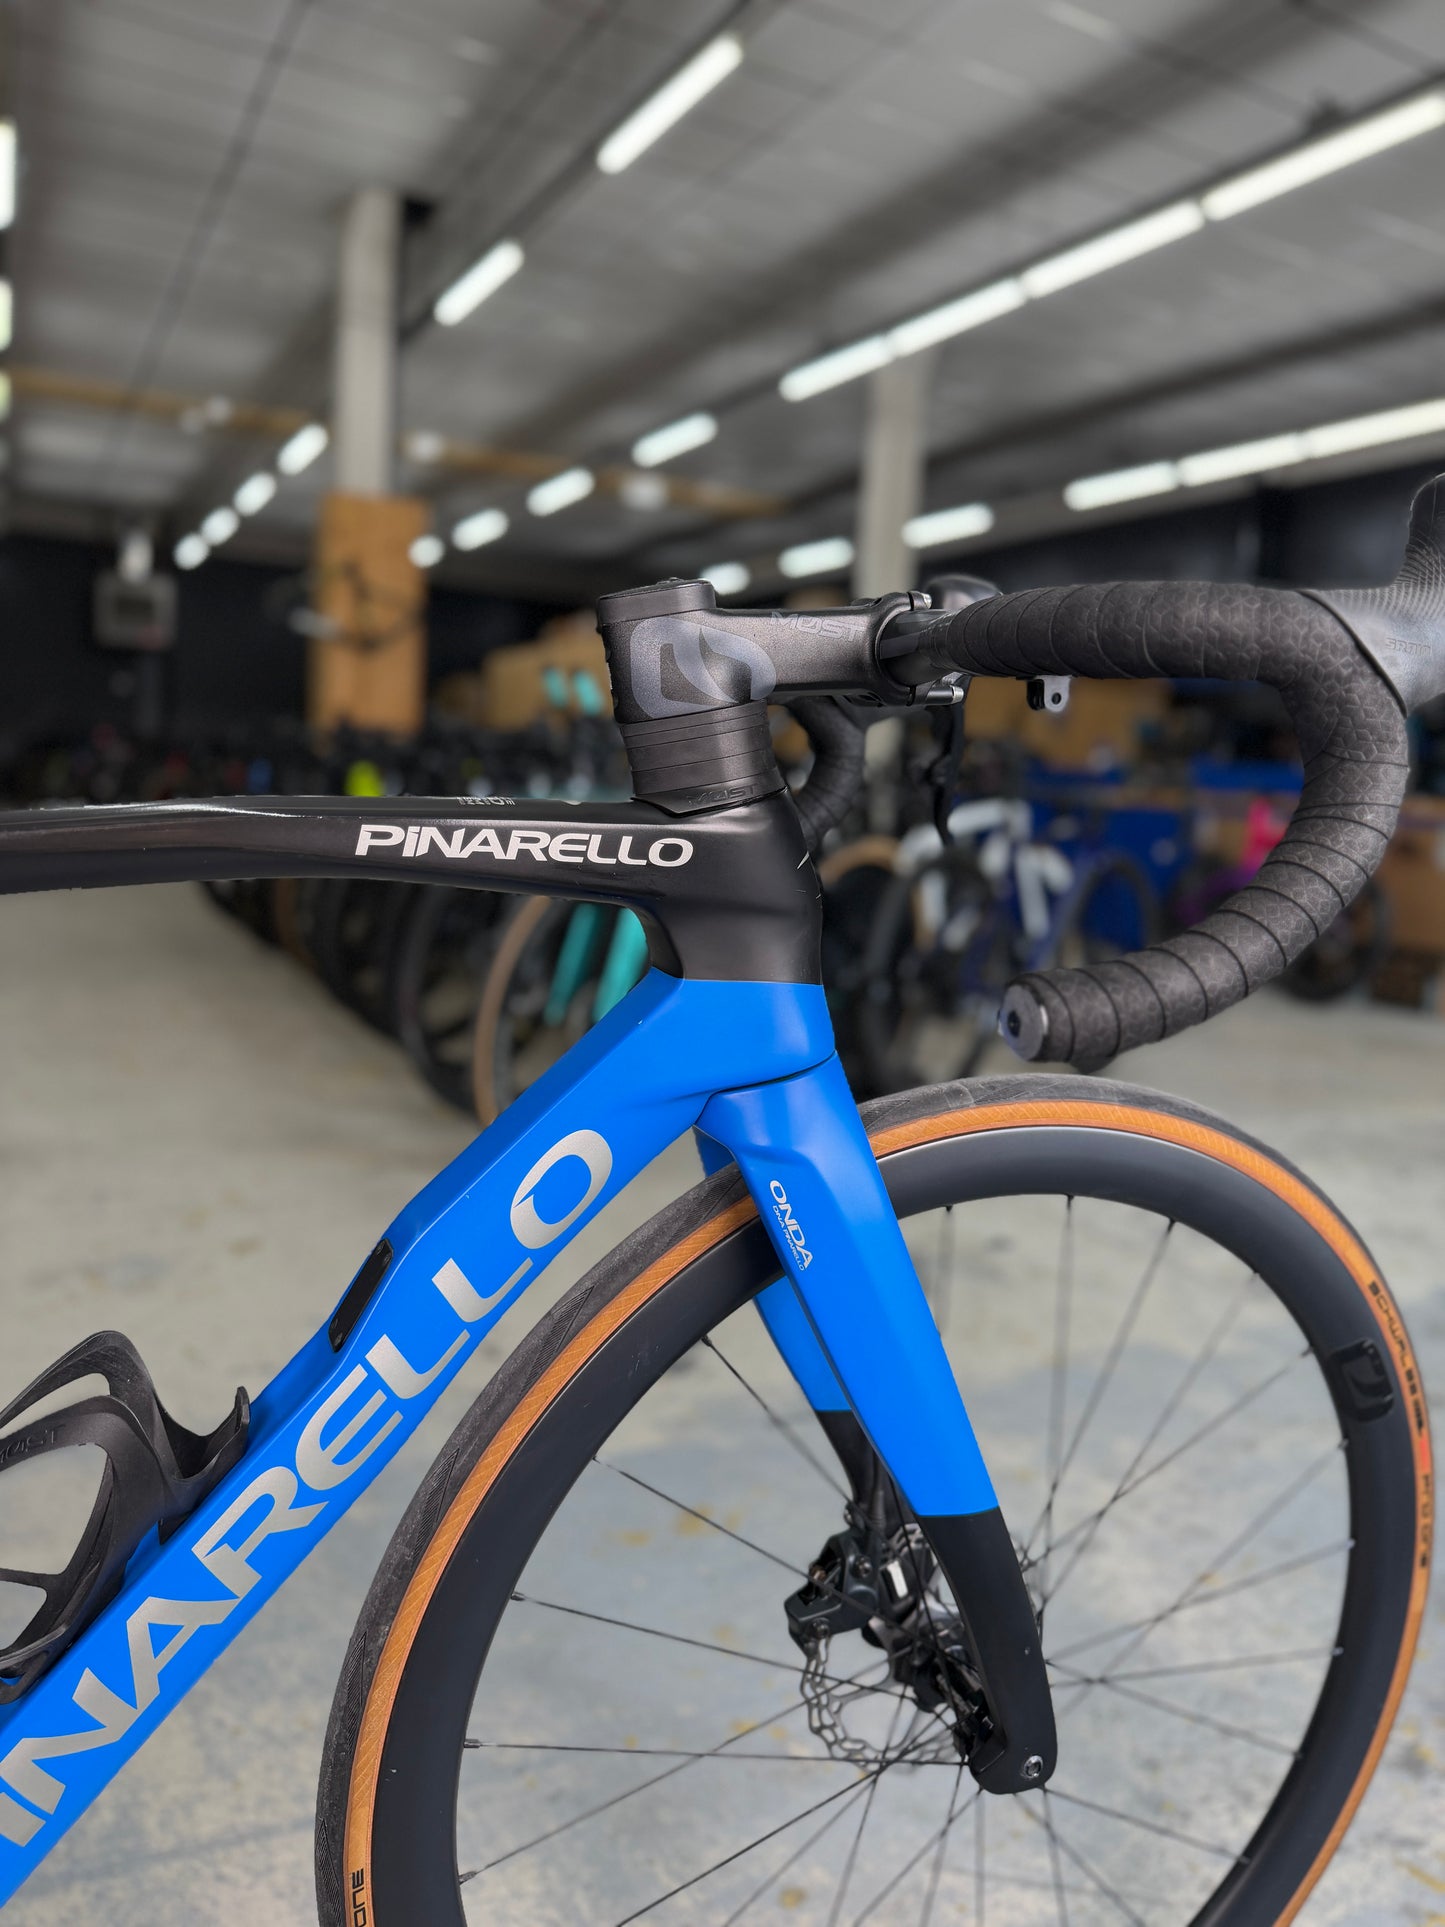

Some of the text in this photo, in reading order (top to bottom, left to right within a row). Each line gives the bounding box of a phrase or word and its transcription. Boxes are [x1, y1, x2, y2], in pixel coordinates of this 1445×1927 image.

[771, 610, 866, 642] MOST
[354, 824, 694, 868] PINARELLO
[769, 1180, 813, 1269] ONDA
[351, 1867, 367, 1927] ONE
